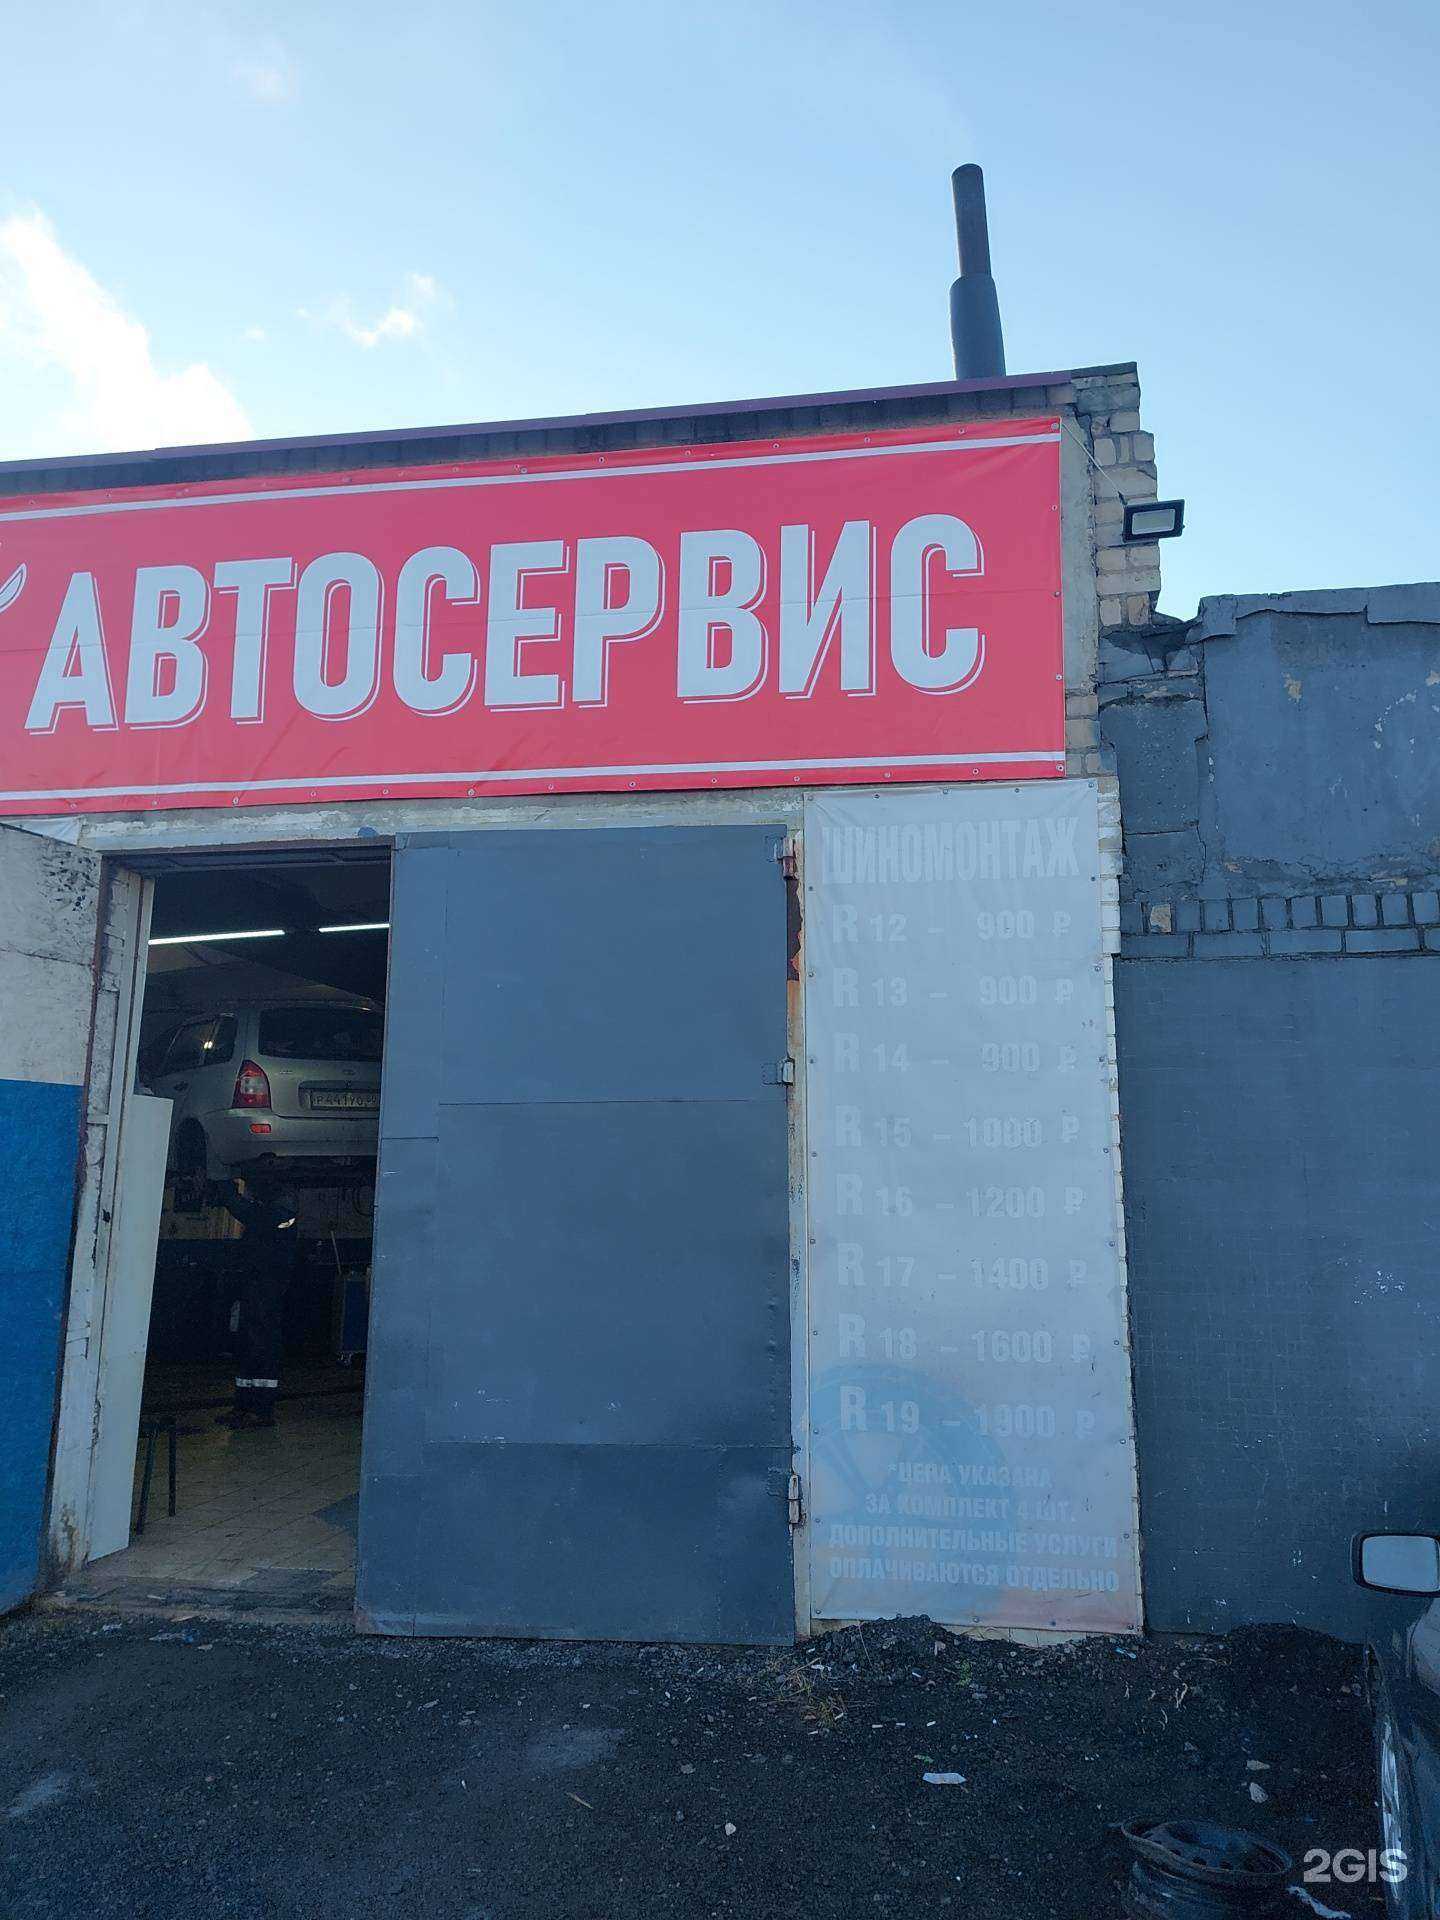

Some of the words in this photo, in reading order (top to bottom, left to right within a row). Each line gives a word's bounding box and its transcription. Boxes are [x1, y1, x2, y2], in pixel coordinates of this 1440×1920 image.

[24, 513, 985, 735] АВТОСЕРВИС
[822, 817, 1079, 884] ШИНОМОНТАЖ
[833, 904, 858, 943] R
[871, 914, 907, 941] 12
[977, 911, 1035, 940] 900
[833, 968, 859, 1006] R
[872, 978, 907, 1007] 13
[980, 976, 1037, 1004] 900
[834, 1033, 860, 1072] R
[874, 1044, 910, 1072] 14
[981, 1043, 1040, 1072] 900
[835, 1105, 862, 1147] R
[875, 1118, 911, 1147] 15
[836, 1174, 863, 1215] R
[876, 1187, 913, 1215] 16
[966, 1187, 1045, 1217] 1200
[837, 1243, 866, 1286] R
[877, 1257, 915, 1287] 17
[970, 1257, 1049, 1290] 1400
[839, 1313, 866, 1357] R
[880, 1327, 917, 1360] 18
[971, 1329, 1052, 1363] 1600
[840, 1386, 868, 1431] R
[881, 1400, 919, 1434] 19
[974, 1404, 1055, 1437] 1900
[958, 1464, 1052, 1487] УКАЗАНА
[865, 1494, 891, 1514] ЗА
[898, 1495, 1009, 1520] КОМПЛЕКТ
[1017, 1501, 1029, 1519] 4
[828, 1524, 1027, 1552] ДОПОЛНИТЕЛЬНЫЕ
[1029, 1534, 1118, 1558] УСЛУГИ
[829, 1557, 1000, 1586] ОПЛАЧИВАЮТСЯ
[1006, 1564, 1119, 1591] ОТДЕЛЬНО
